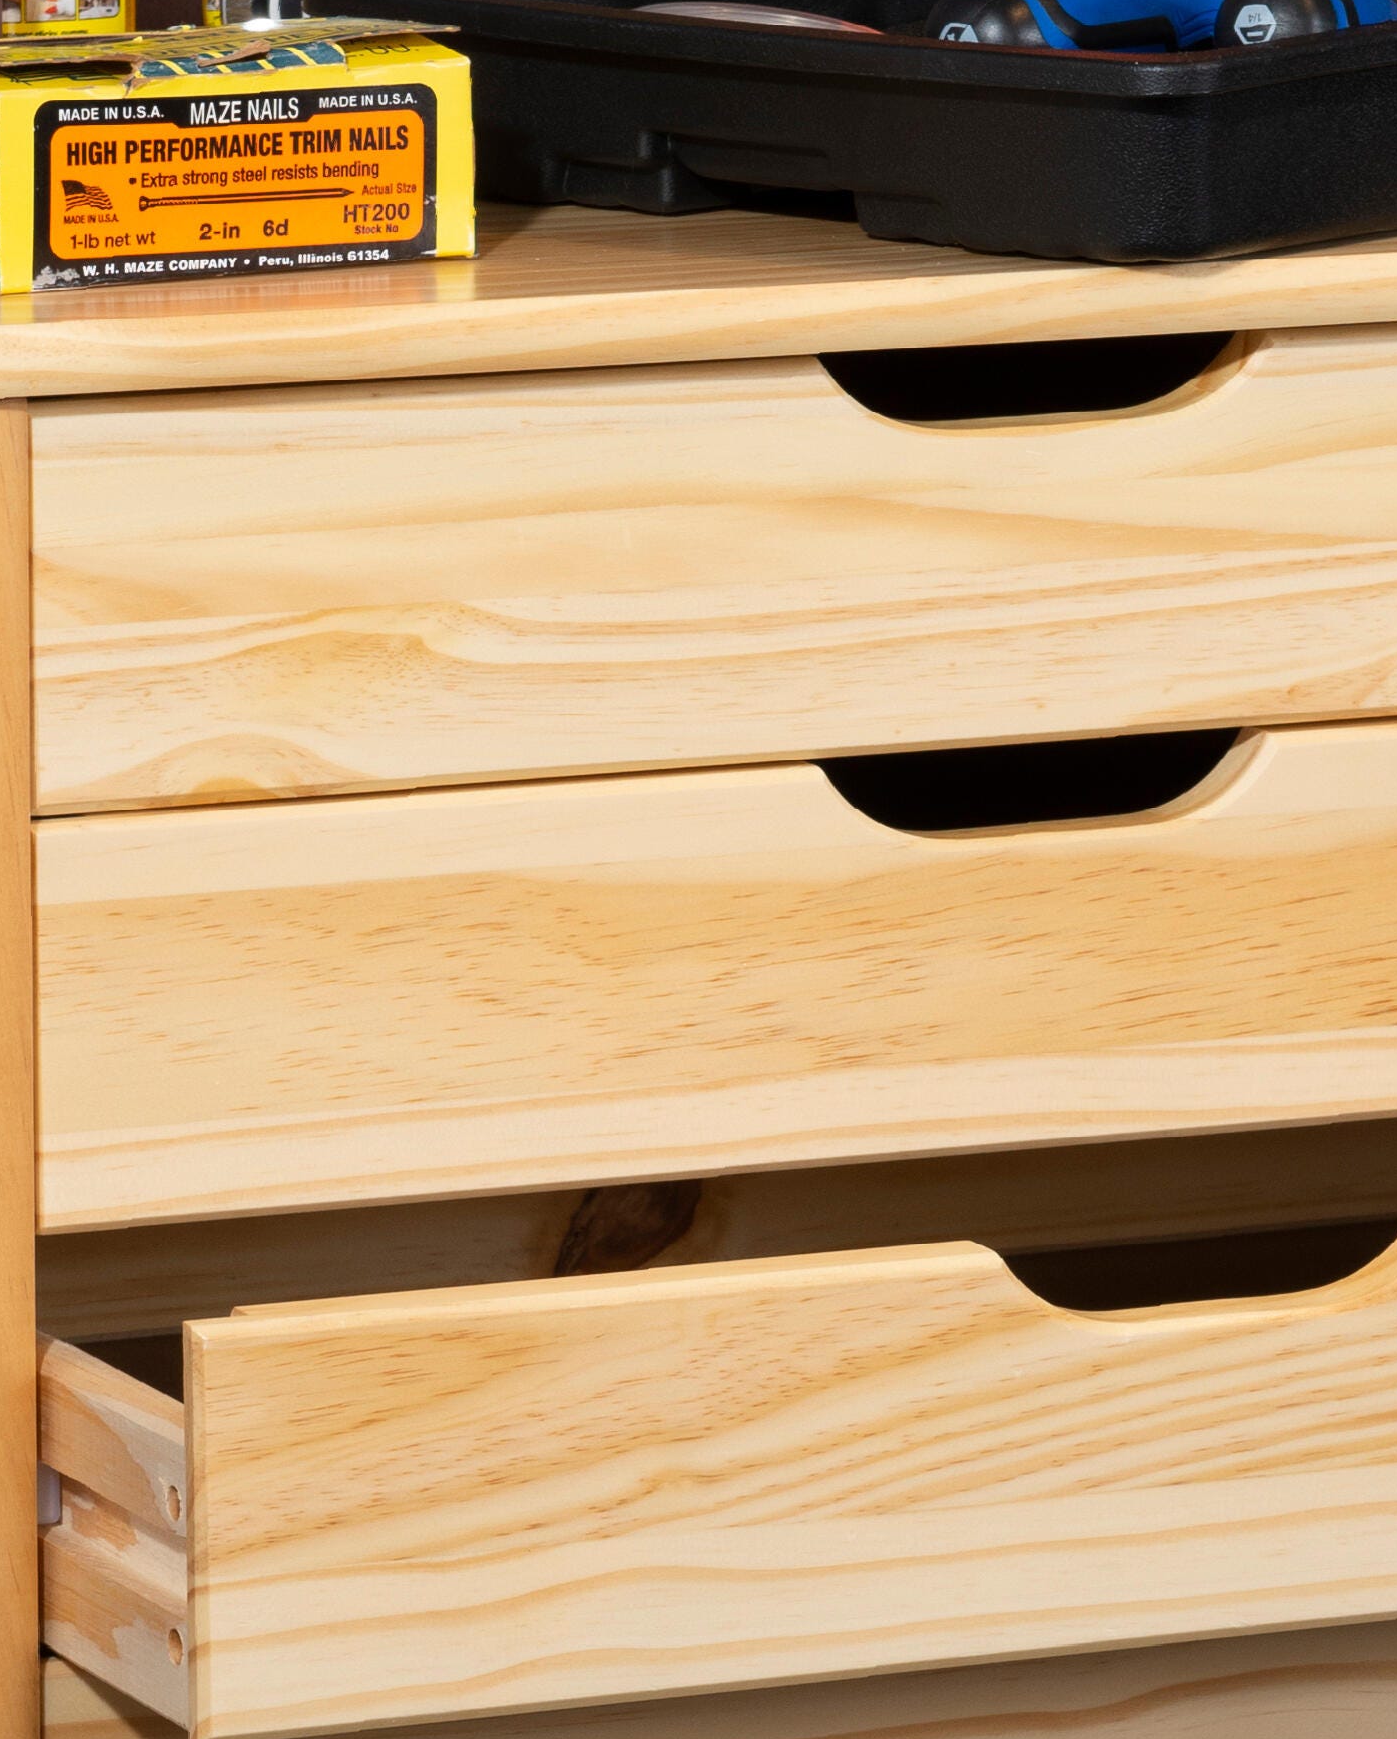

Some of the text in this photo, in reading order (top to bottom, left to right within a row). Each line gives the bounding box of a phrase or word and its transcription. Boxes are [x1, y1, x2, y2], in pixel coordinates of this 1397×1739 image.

[318, 92, 418, 108] MADE IN U.S.A.
[58, 105, 164, 122] MADE IN U.S.A.
[190, 97, 299, 125] MAZE NAILS
[66, 124, 409, 166] HIGH PERFORMANCE TRIM NAILS
[141, 161, 379, 188] Extra strong steel resists bending
[361, 182, 417, 196] Actual Size
[63, 213, 119, 224] MADE IN U.S.A.
[343, 203, 410, 223] HT200
[199, 219, 289, 240] 2-in 6d
[354, 224, 382, 236] Stock
[70, 231, 156, 249] 1-lb net wt
[83, 249, 390, 277] W. H. MAZE COMPANY Peru, Illinois 61354
